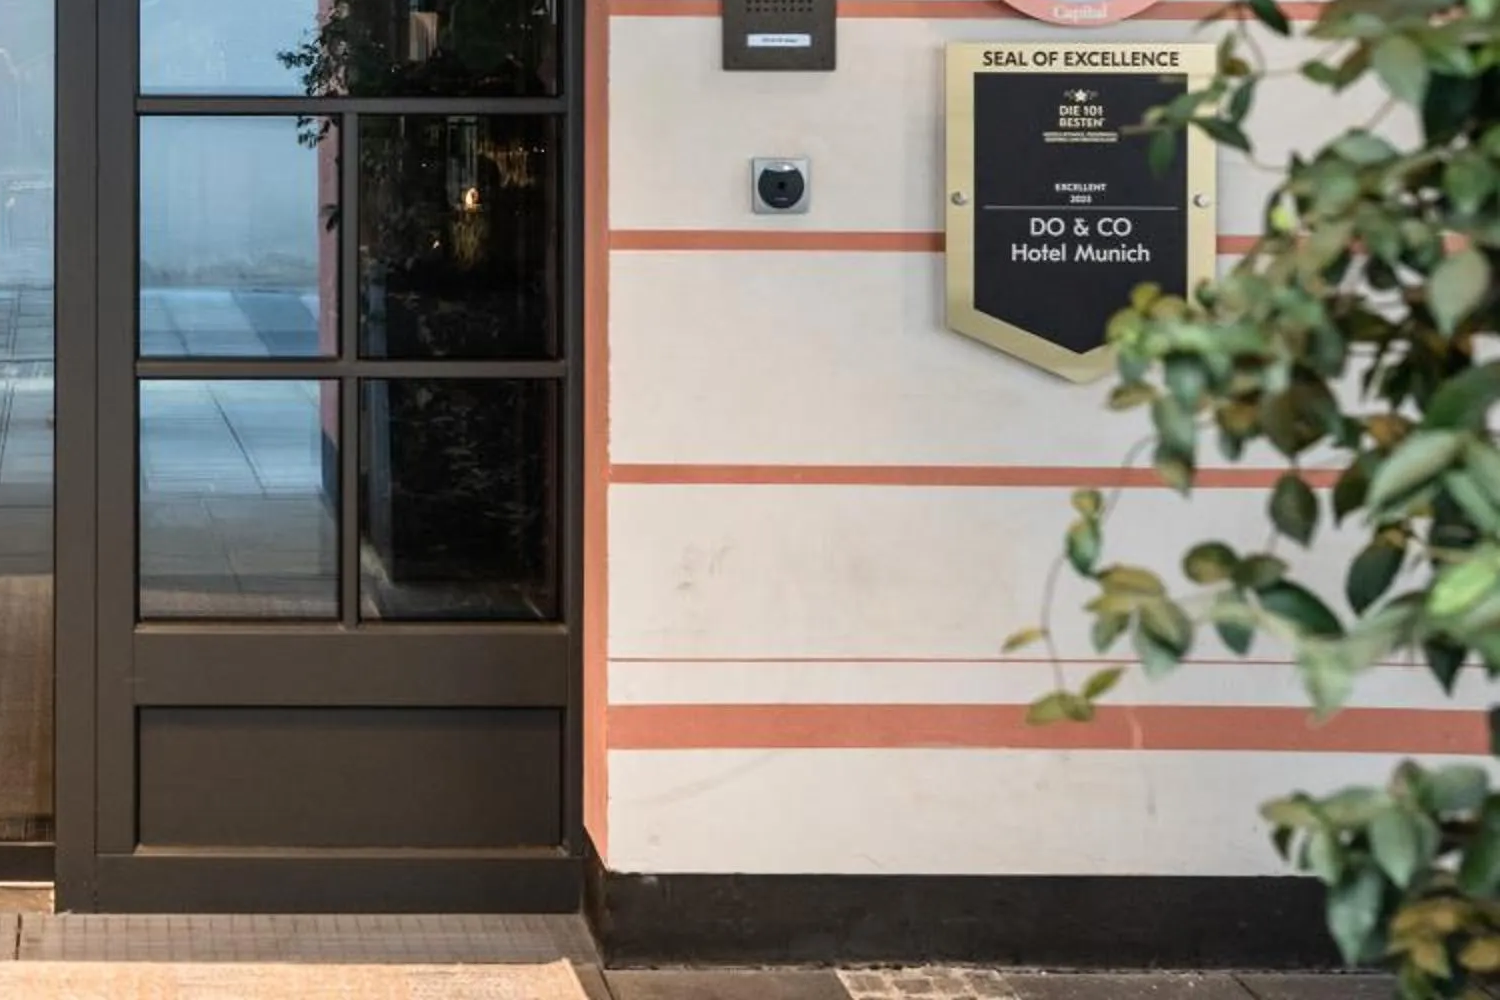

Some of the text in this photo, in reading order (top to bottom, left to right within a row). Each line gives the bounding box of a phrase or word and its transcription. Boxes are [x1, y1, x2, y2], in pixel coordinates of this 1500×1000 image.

[983, 51, 1180, 67] SEAL OF EXCELLENCE
[1059, 105, 1081, 117] DIE
[1055, 183, 1107, 192] EXCELLENT
[1030, 218, 1132, 237] DO & CO
[1011, 243, 1151, 263] Hotel Munich
